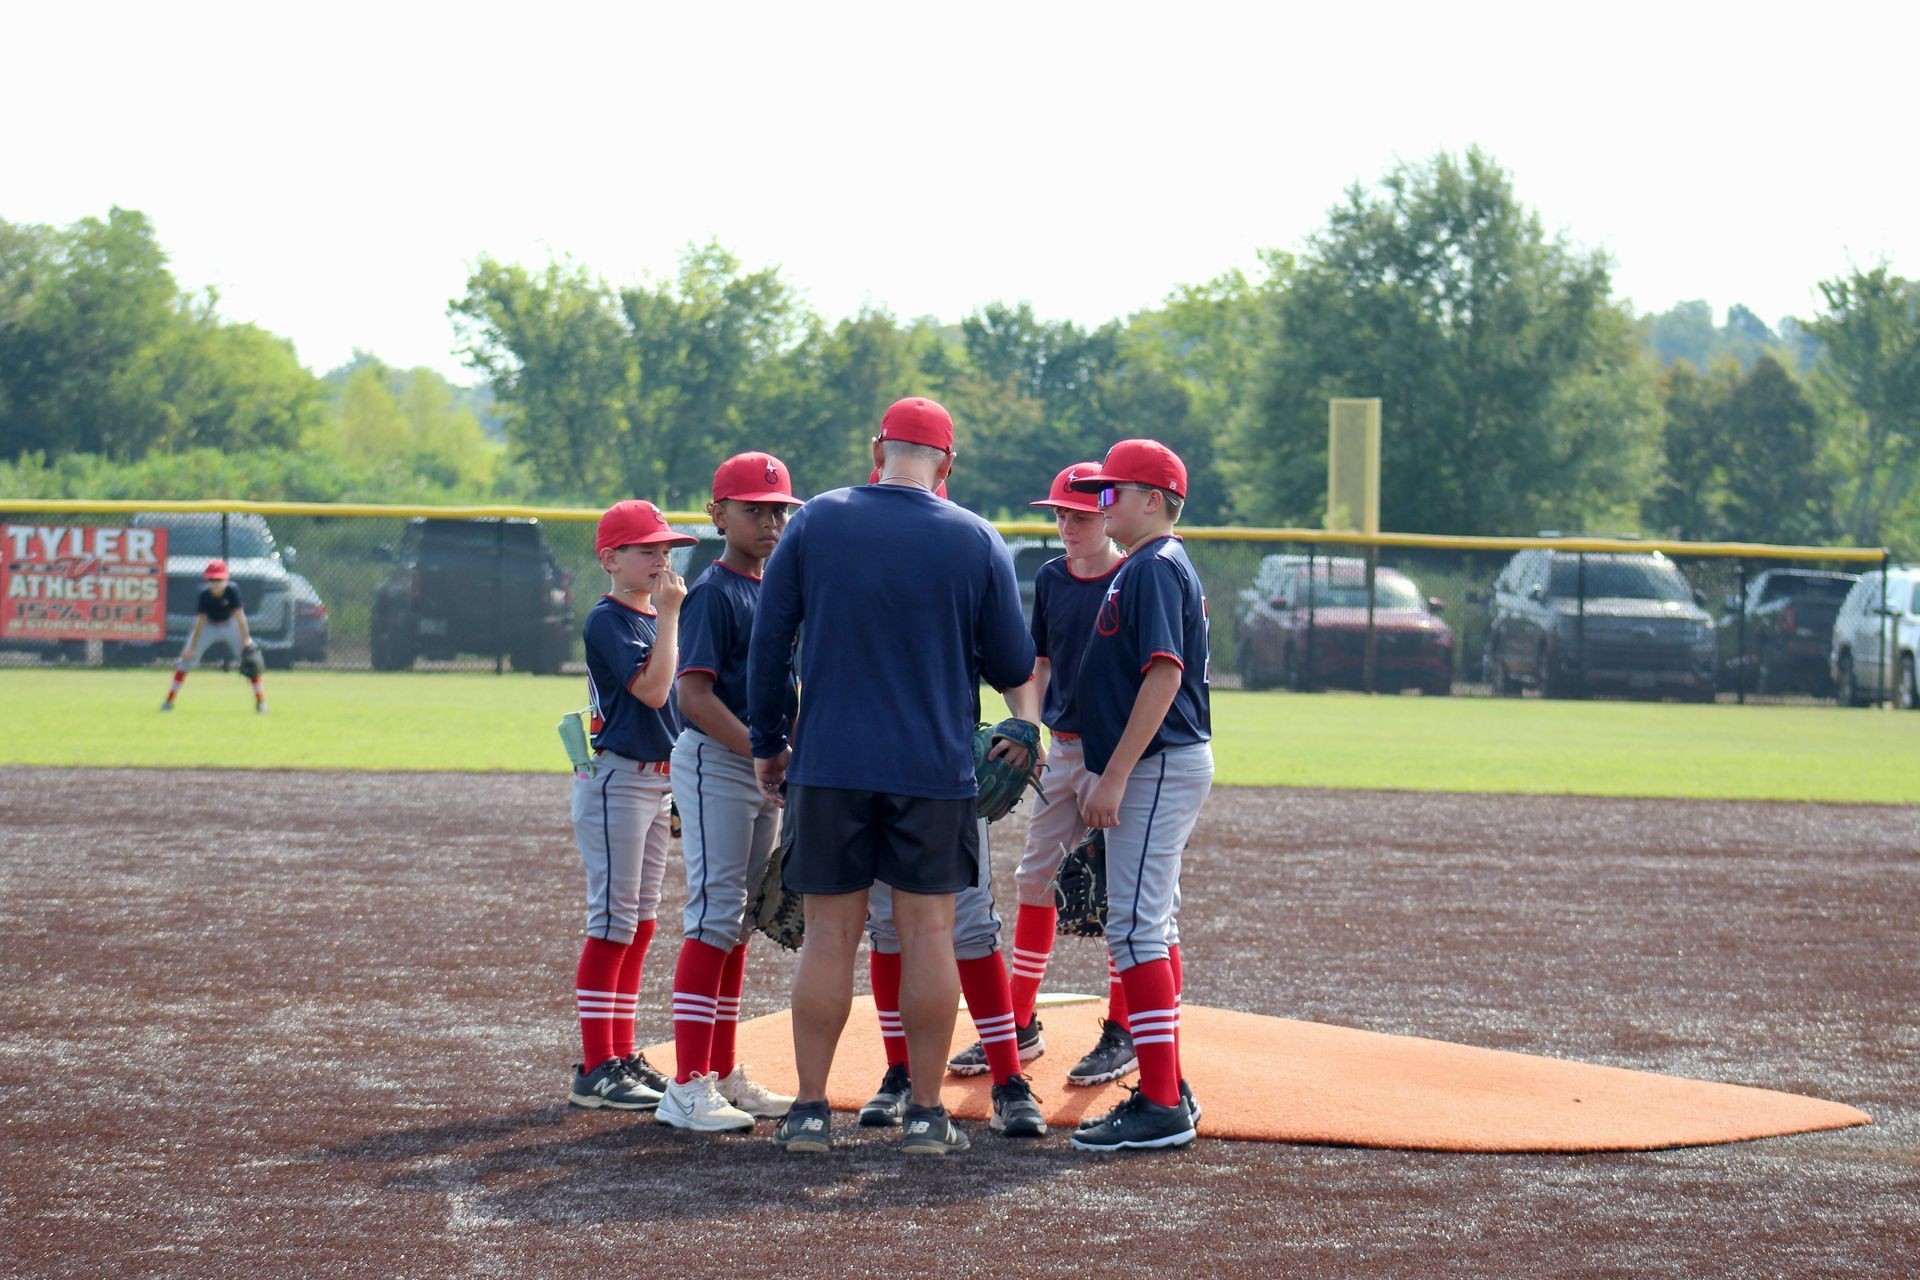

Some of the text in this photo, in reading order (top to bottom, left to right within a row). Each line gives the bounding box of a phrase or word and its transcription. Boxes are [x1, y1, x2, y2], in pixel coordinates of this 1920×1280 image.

[7, 526, 159, 564] TYLER
[8, 574, 160, 602] ATHLETICS
[17, 602, 156, 622] 15% OFF
